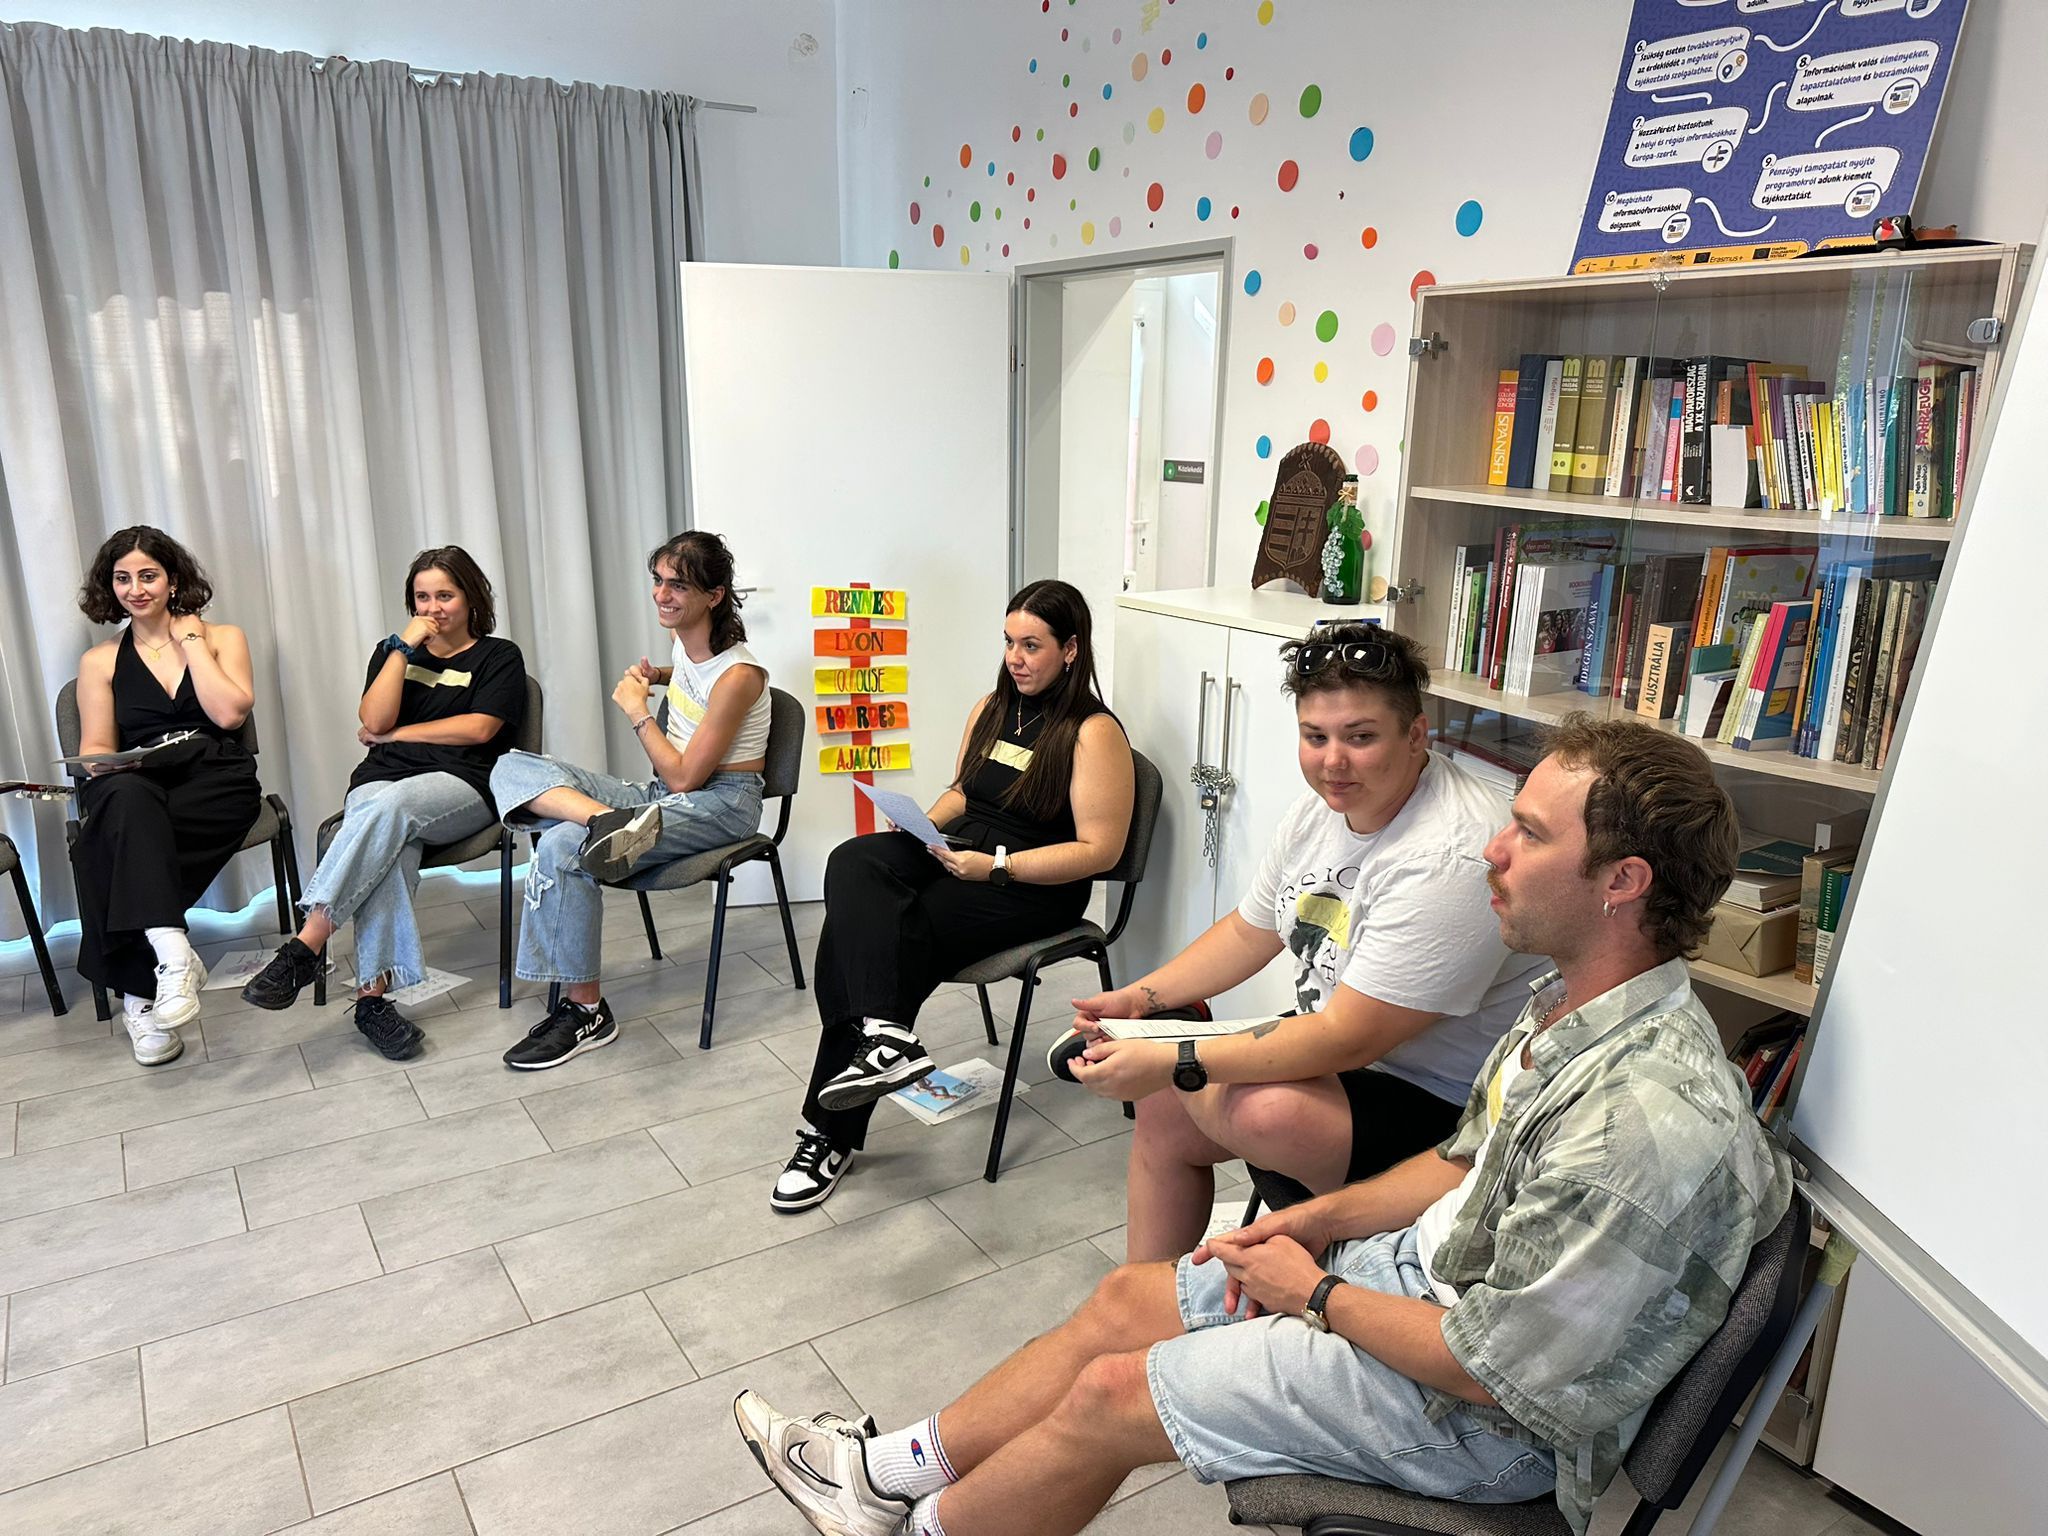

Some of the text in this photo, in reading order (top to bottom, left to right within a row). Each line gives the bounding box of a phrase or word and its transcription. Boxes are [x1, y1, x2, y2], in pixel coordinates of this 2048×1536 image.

[1640, 49, 1666, 61] Szükség
[1803, 61, 1856, 78] Információink
[1858, 57, 1878, 69] valós
[1800, 64, 1929, 93] tapasztalatokon és beszámolókon
[1769, 155, 1875, 178] Pénzügyi támogatást nyújtó
[1764, 170, 1873, 192] programokról adunk kiemelt
[1917, 377, 1932, 446] FAHRZEUGE
[1493, 415, 1509, 474] SPANISH
[825, 589, 895, 616] RENNES
[835, 631, 884, 652] LYON
[1580, 600, 1599, 684] IDEGEN SZAVAK
[1646, 641, 1665, 704] AUSZTRÁLIA
[826, 704, 895, 730] LOURDES
[836, 746, 891, 770] AJACCIO
[575, 1014, 604, 1042] FILA
